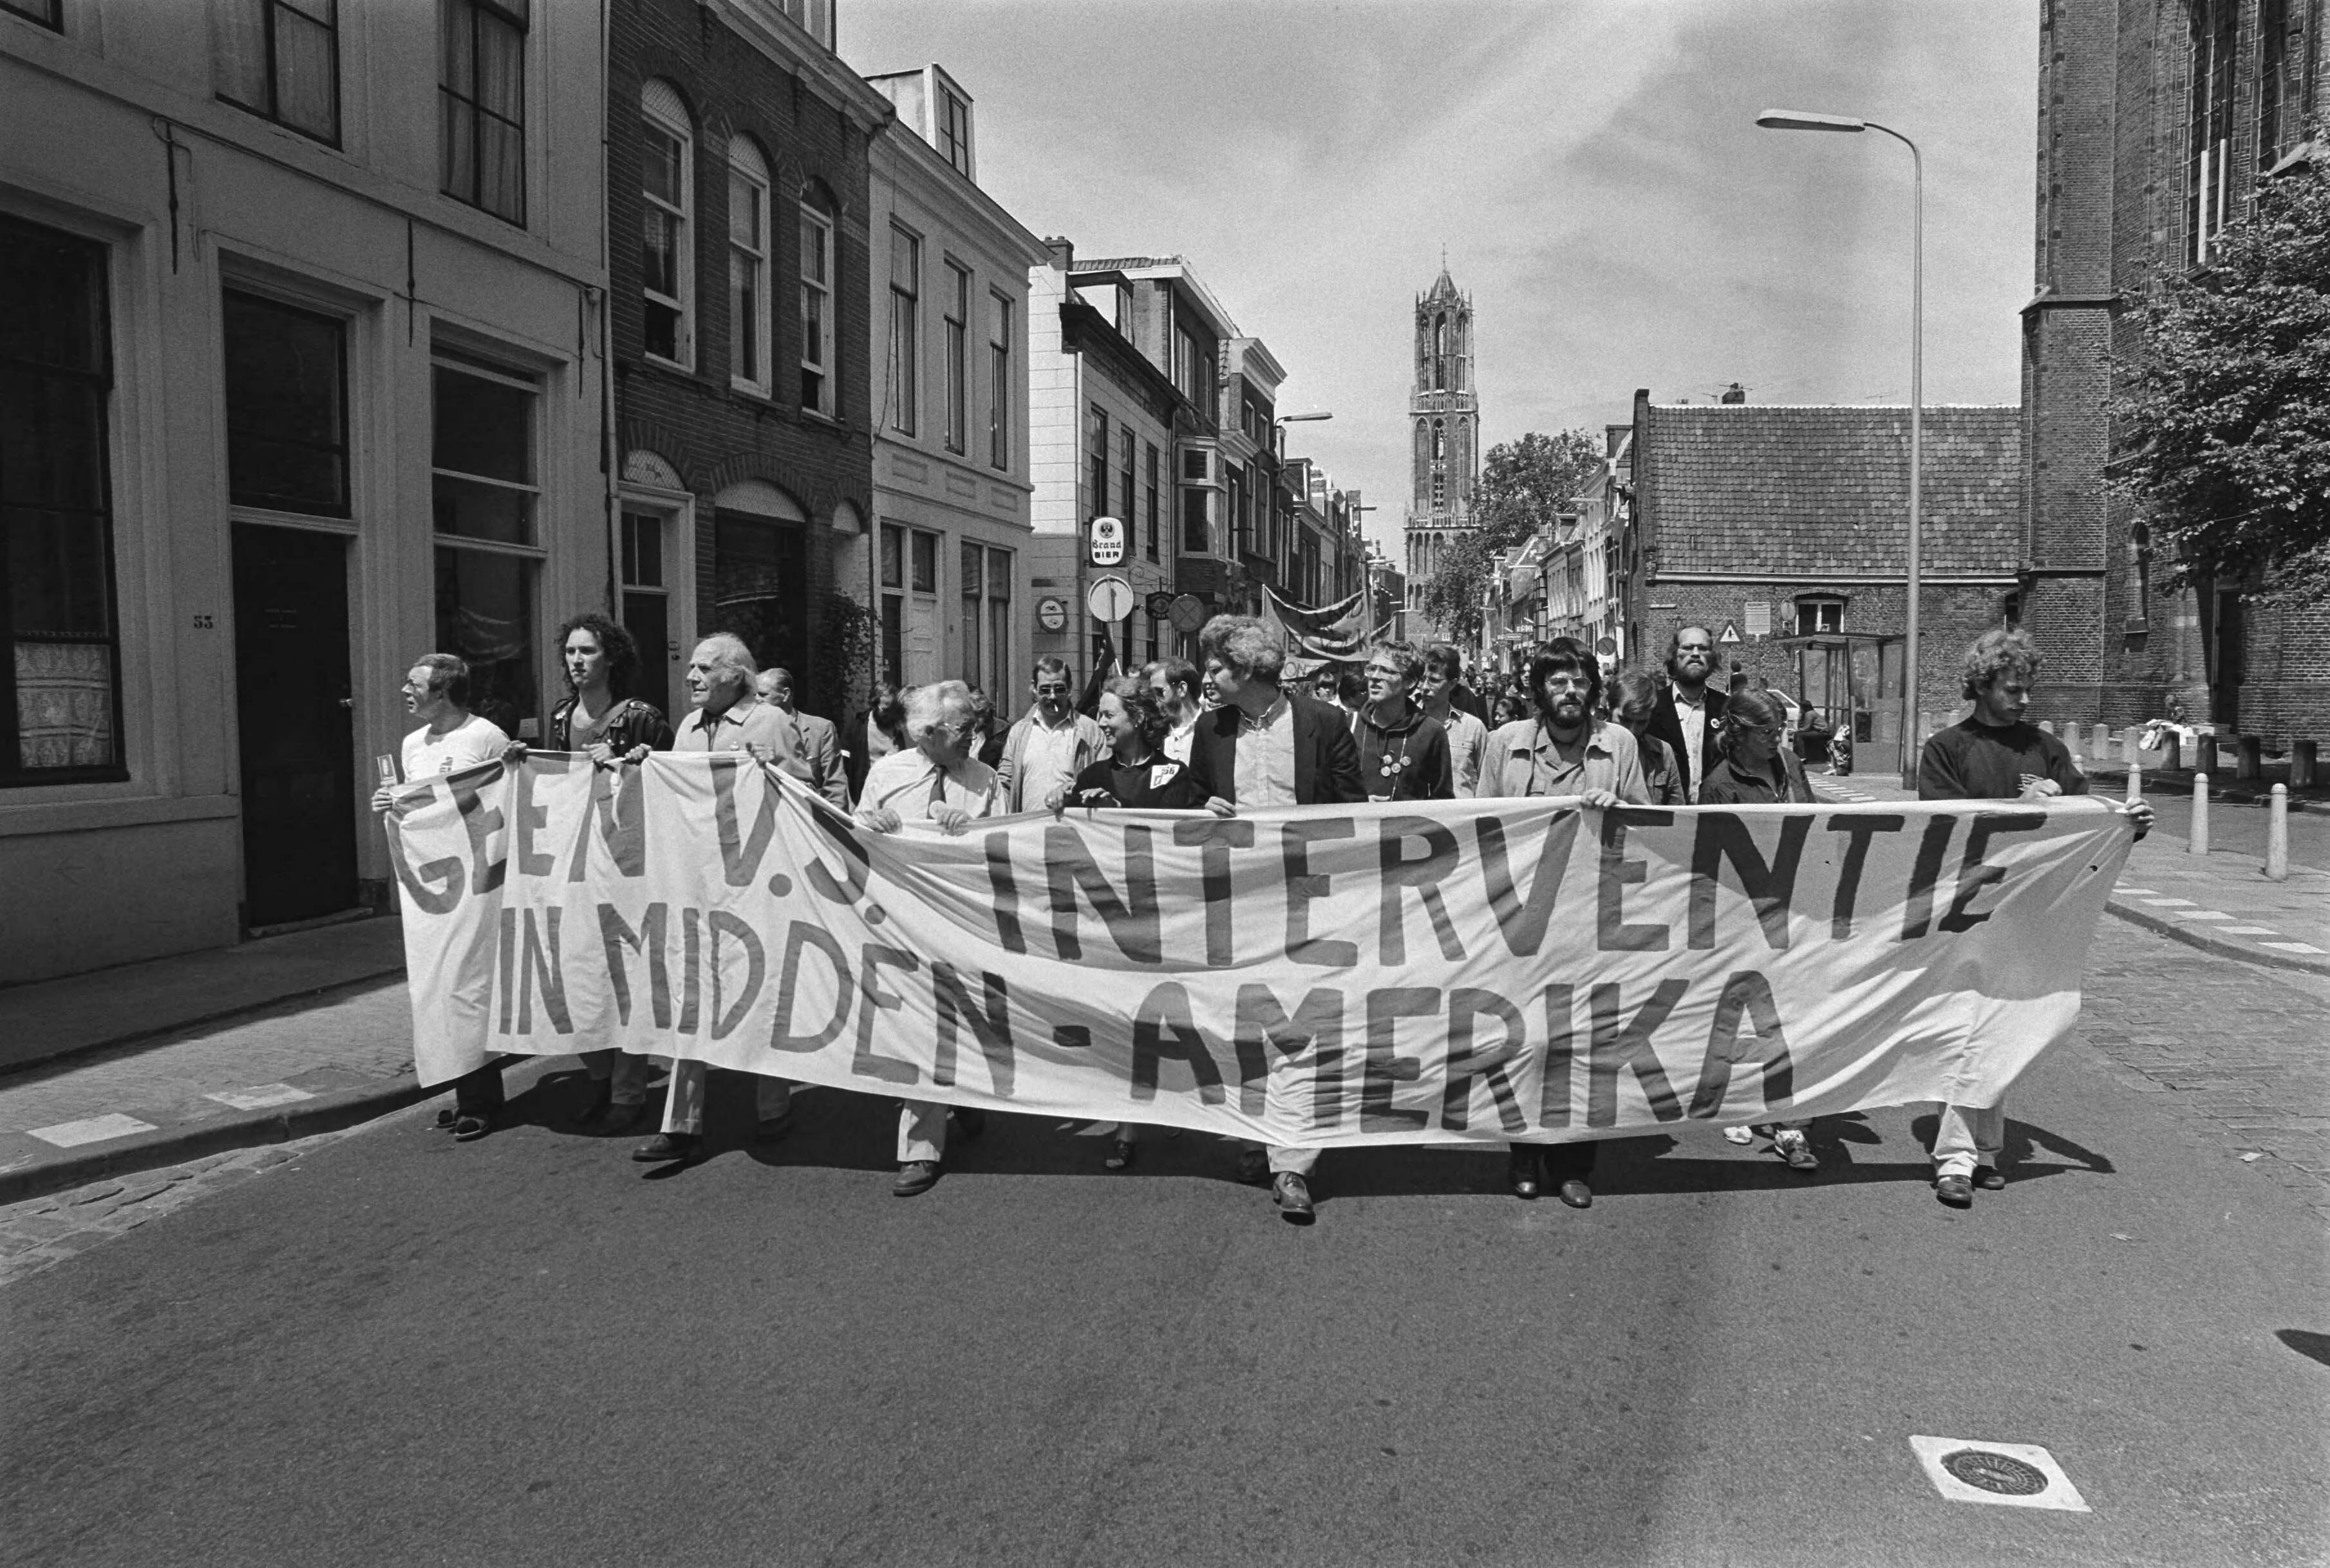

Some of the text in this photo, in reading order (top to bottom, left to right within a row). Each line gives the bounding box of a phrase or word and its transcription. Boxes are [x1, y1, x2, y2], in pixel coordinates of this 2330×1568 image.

[385, 751, 645, 914] GEEN
[983, 810, 2047, 967] INTERVENTIE
[499, 906, 574, 1036] IN
